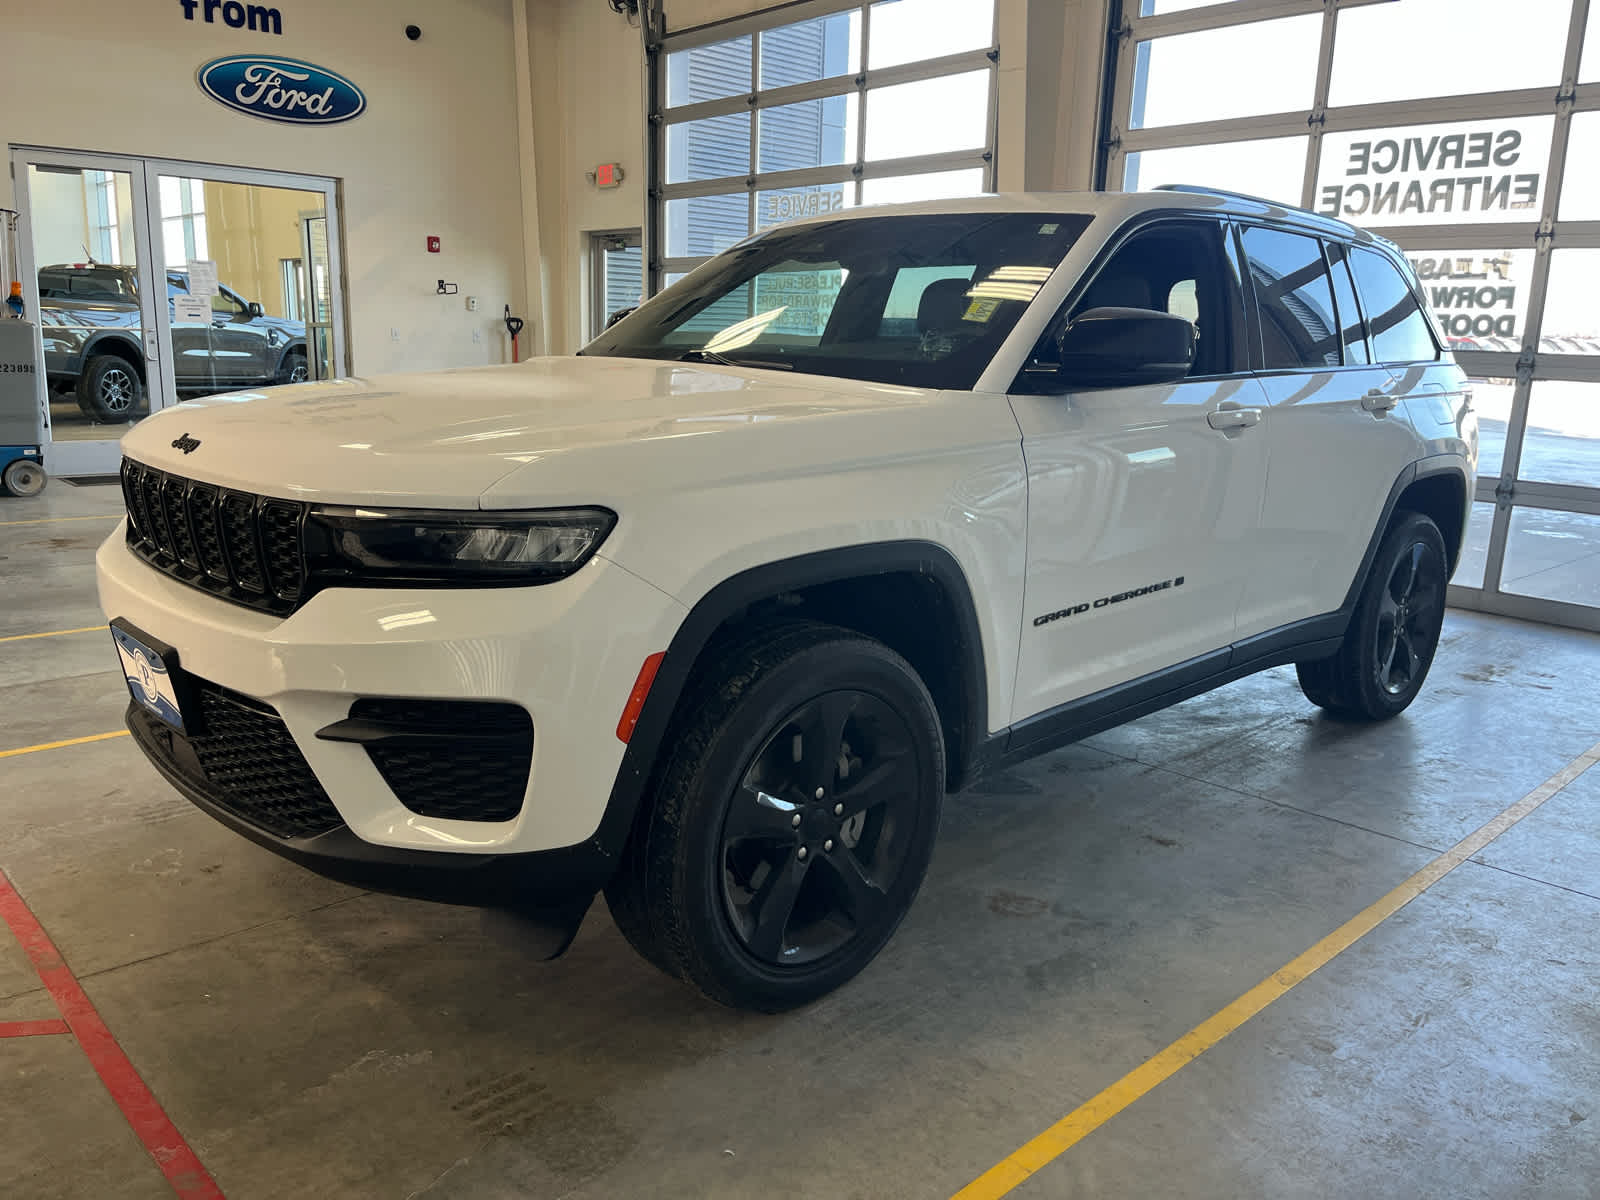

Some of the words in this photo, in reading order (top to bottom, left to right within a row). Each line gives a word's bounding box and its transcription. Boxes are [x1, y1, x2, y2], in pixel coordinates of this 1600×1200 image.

[180, 0, 282, 35] from
[235, 64, 334, 116] Ford
[171, 432, 202, 455] Jeep
[1033, 602, 1090, 627] GRAND
[1093, 580, 1173, 609] CHEROKEE
